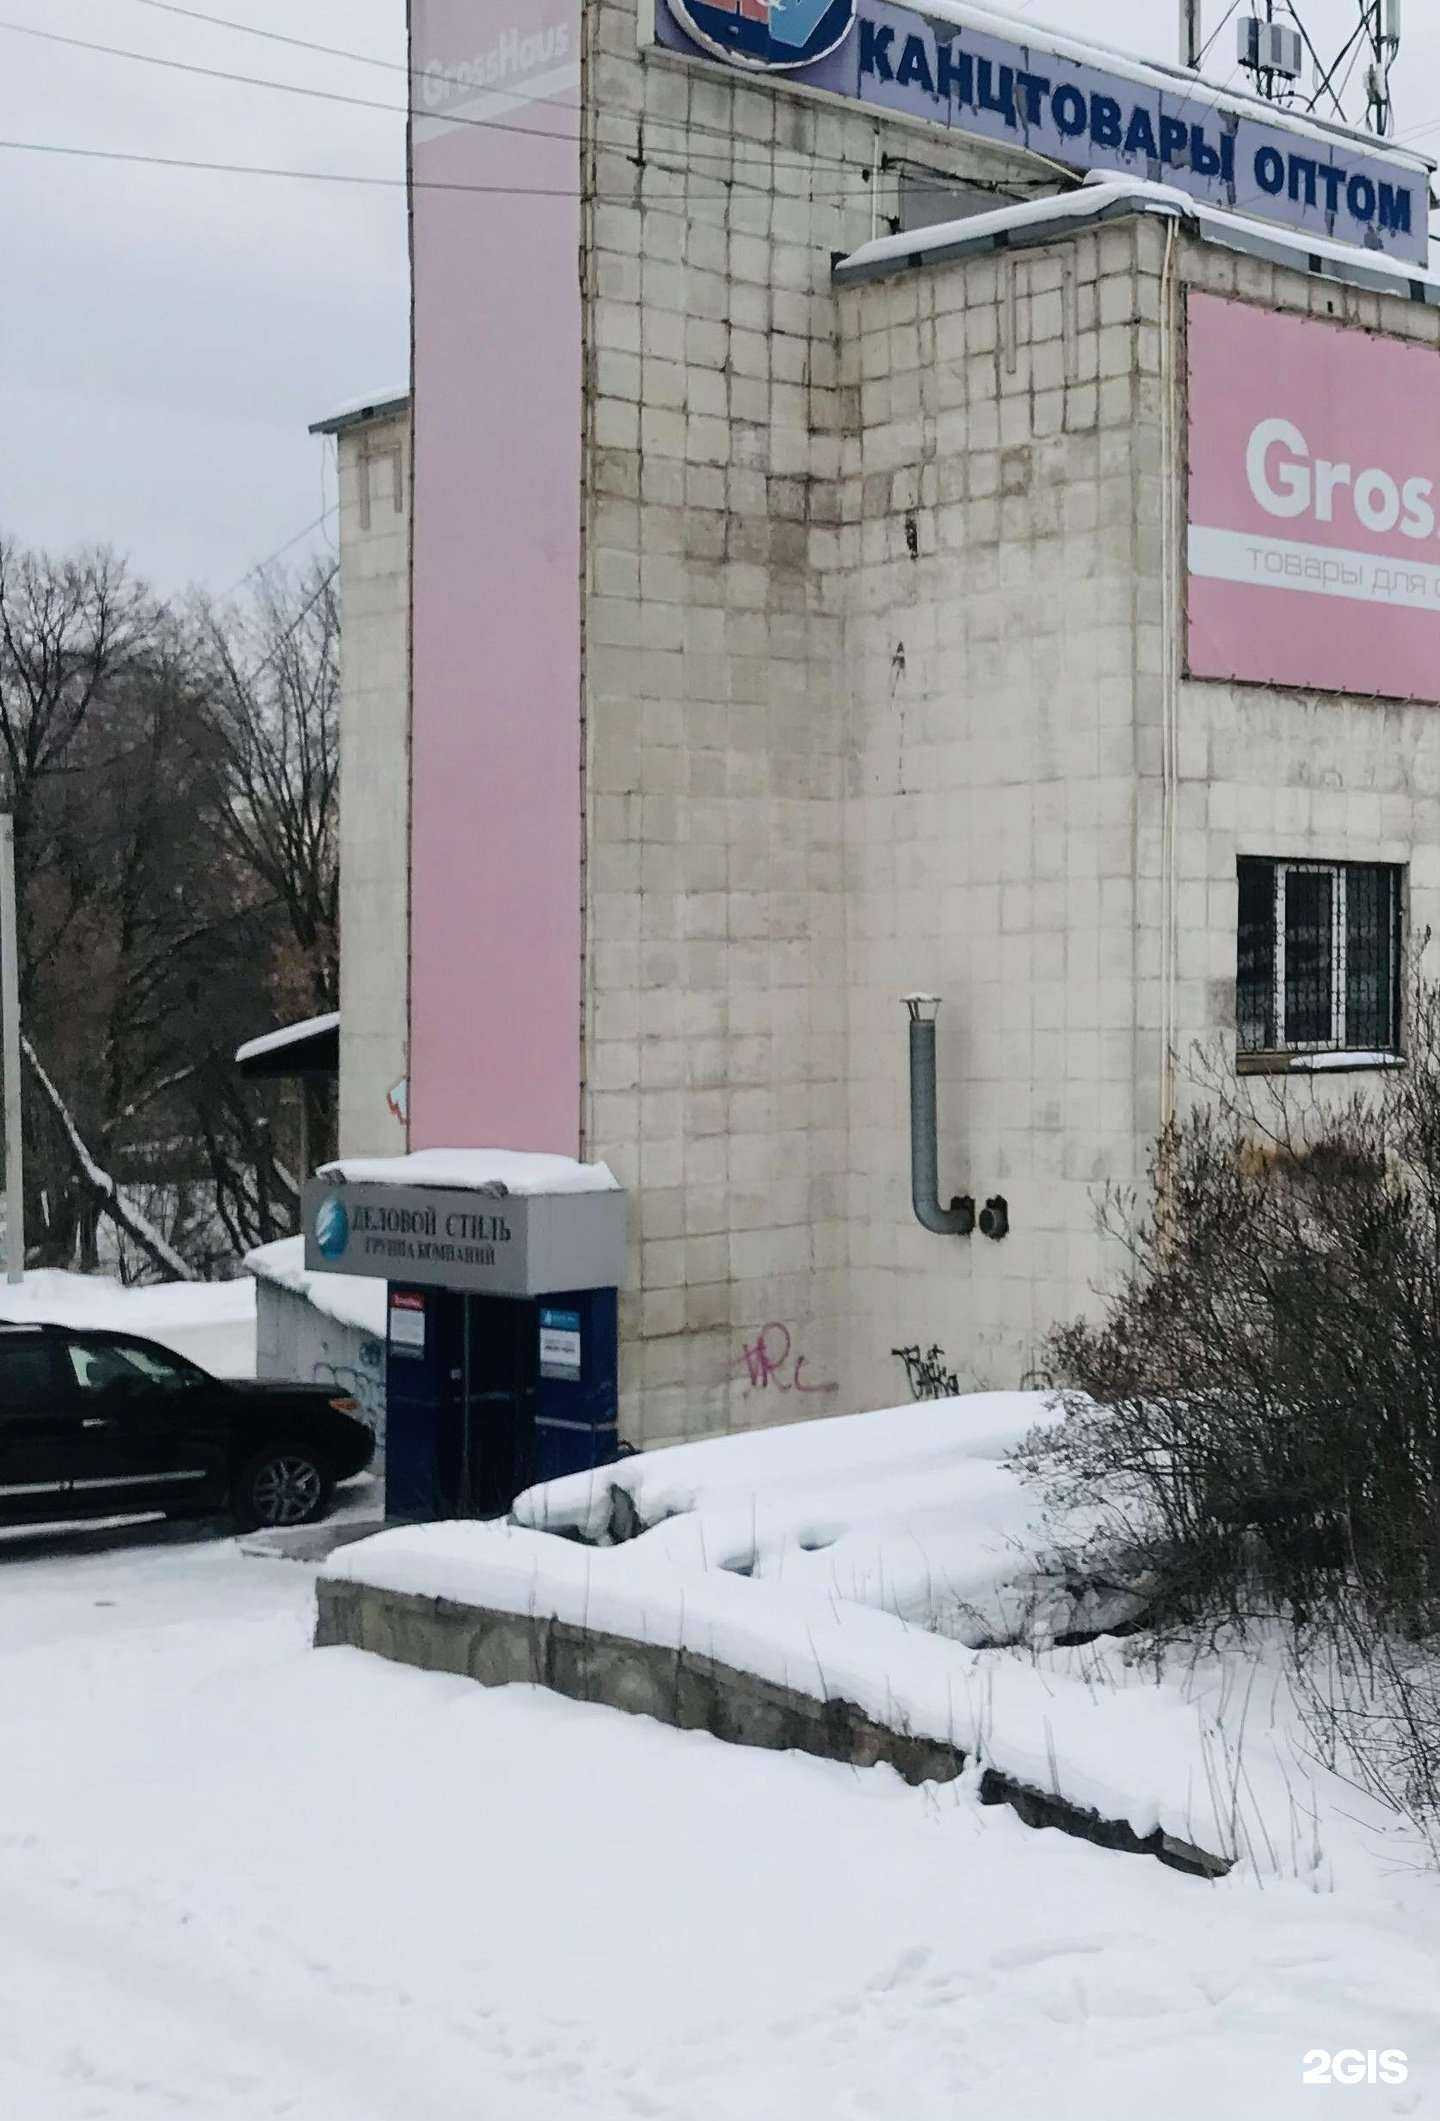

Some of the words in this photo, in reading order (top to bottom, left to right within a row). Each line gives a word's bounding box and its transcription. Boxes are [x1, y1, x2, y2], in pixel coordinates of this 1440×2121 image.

[860, 18, 1235, 182] КАНЦТОВАРЫ
[1254, 146, 1411, 233] ОПТОМ
[1246, 418, 1440, 539] Gros
[1372, 567, 1426, 596] для
[351, 1204, 437, 1236] ДЕЛОВОЙ
[446, 1213, 512, 1241] СТИЛЬ
[366, 1236, 415, 1260] ГРУППА
[417, 1241, 496, 1267] КОМПАНИЙ
